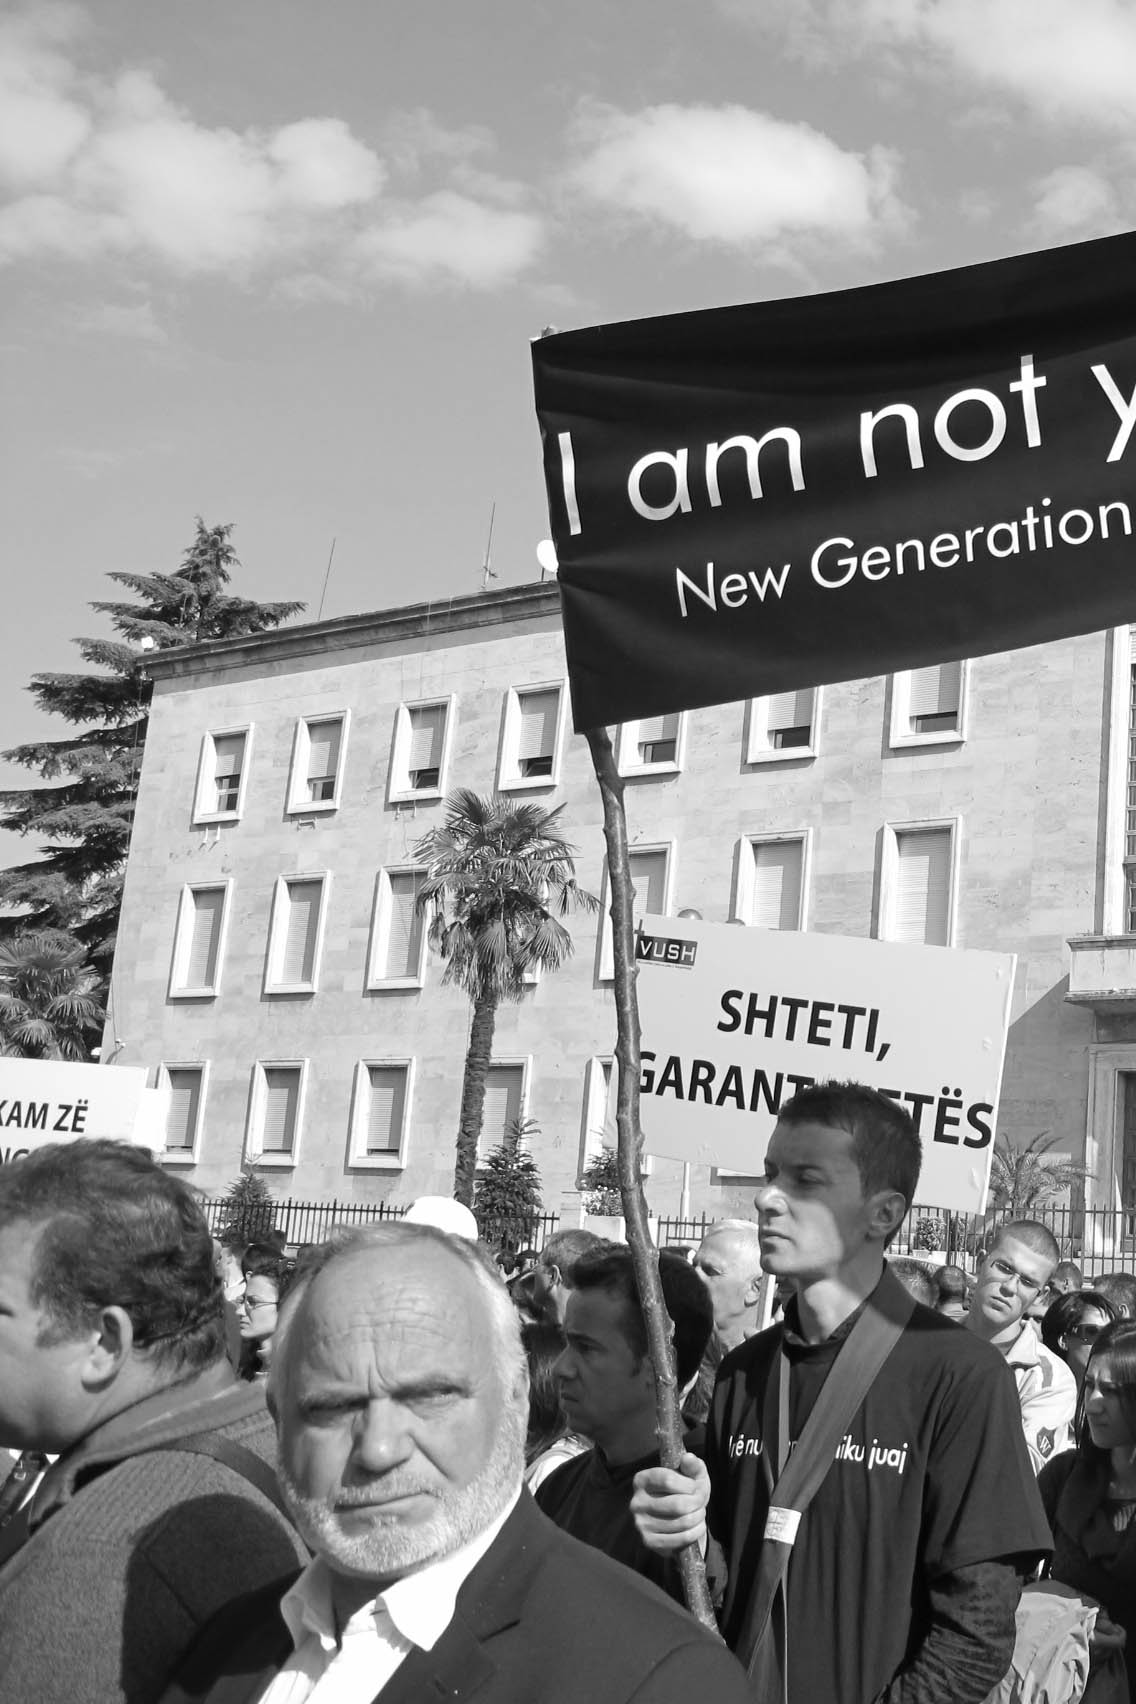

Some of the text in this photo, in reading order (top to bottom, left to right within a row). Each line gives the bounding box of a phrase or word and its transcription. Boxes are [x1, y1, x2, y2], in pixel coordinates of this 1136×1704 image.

[558, 431, 582, 536] I
[627, 426, 806, 521] am
[859, 354, 1047, 478] not
[675, 561, 792, 617] New
[810, 498, 1133, 589] Generation
[640, 940, 696, 962] VUSH
[716, 989, 891, 1061] SHTETI,
[53, 1099, 89, 1133] ZË
[868, 1438, 909, 1475] juaj
